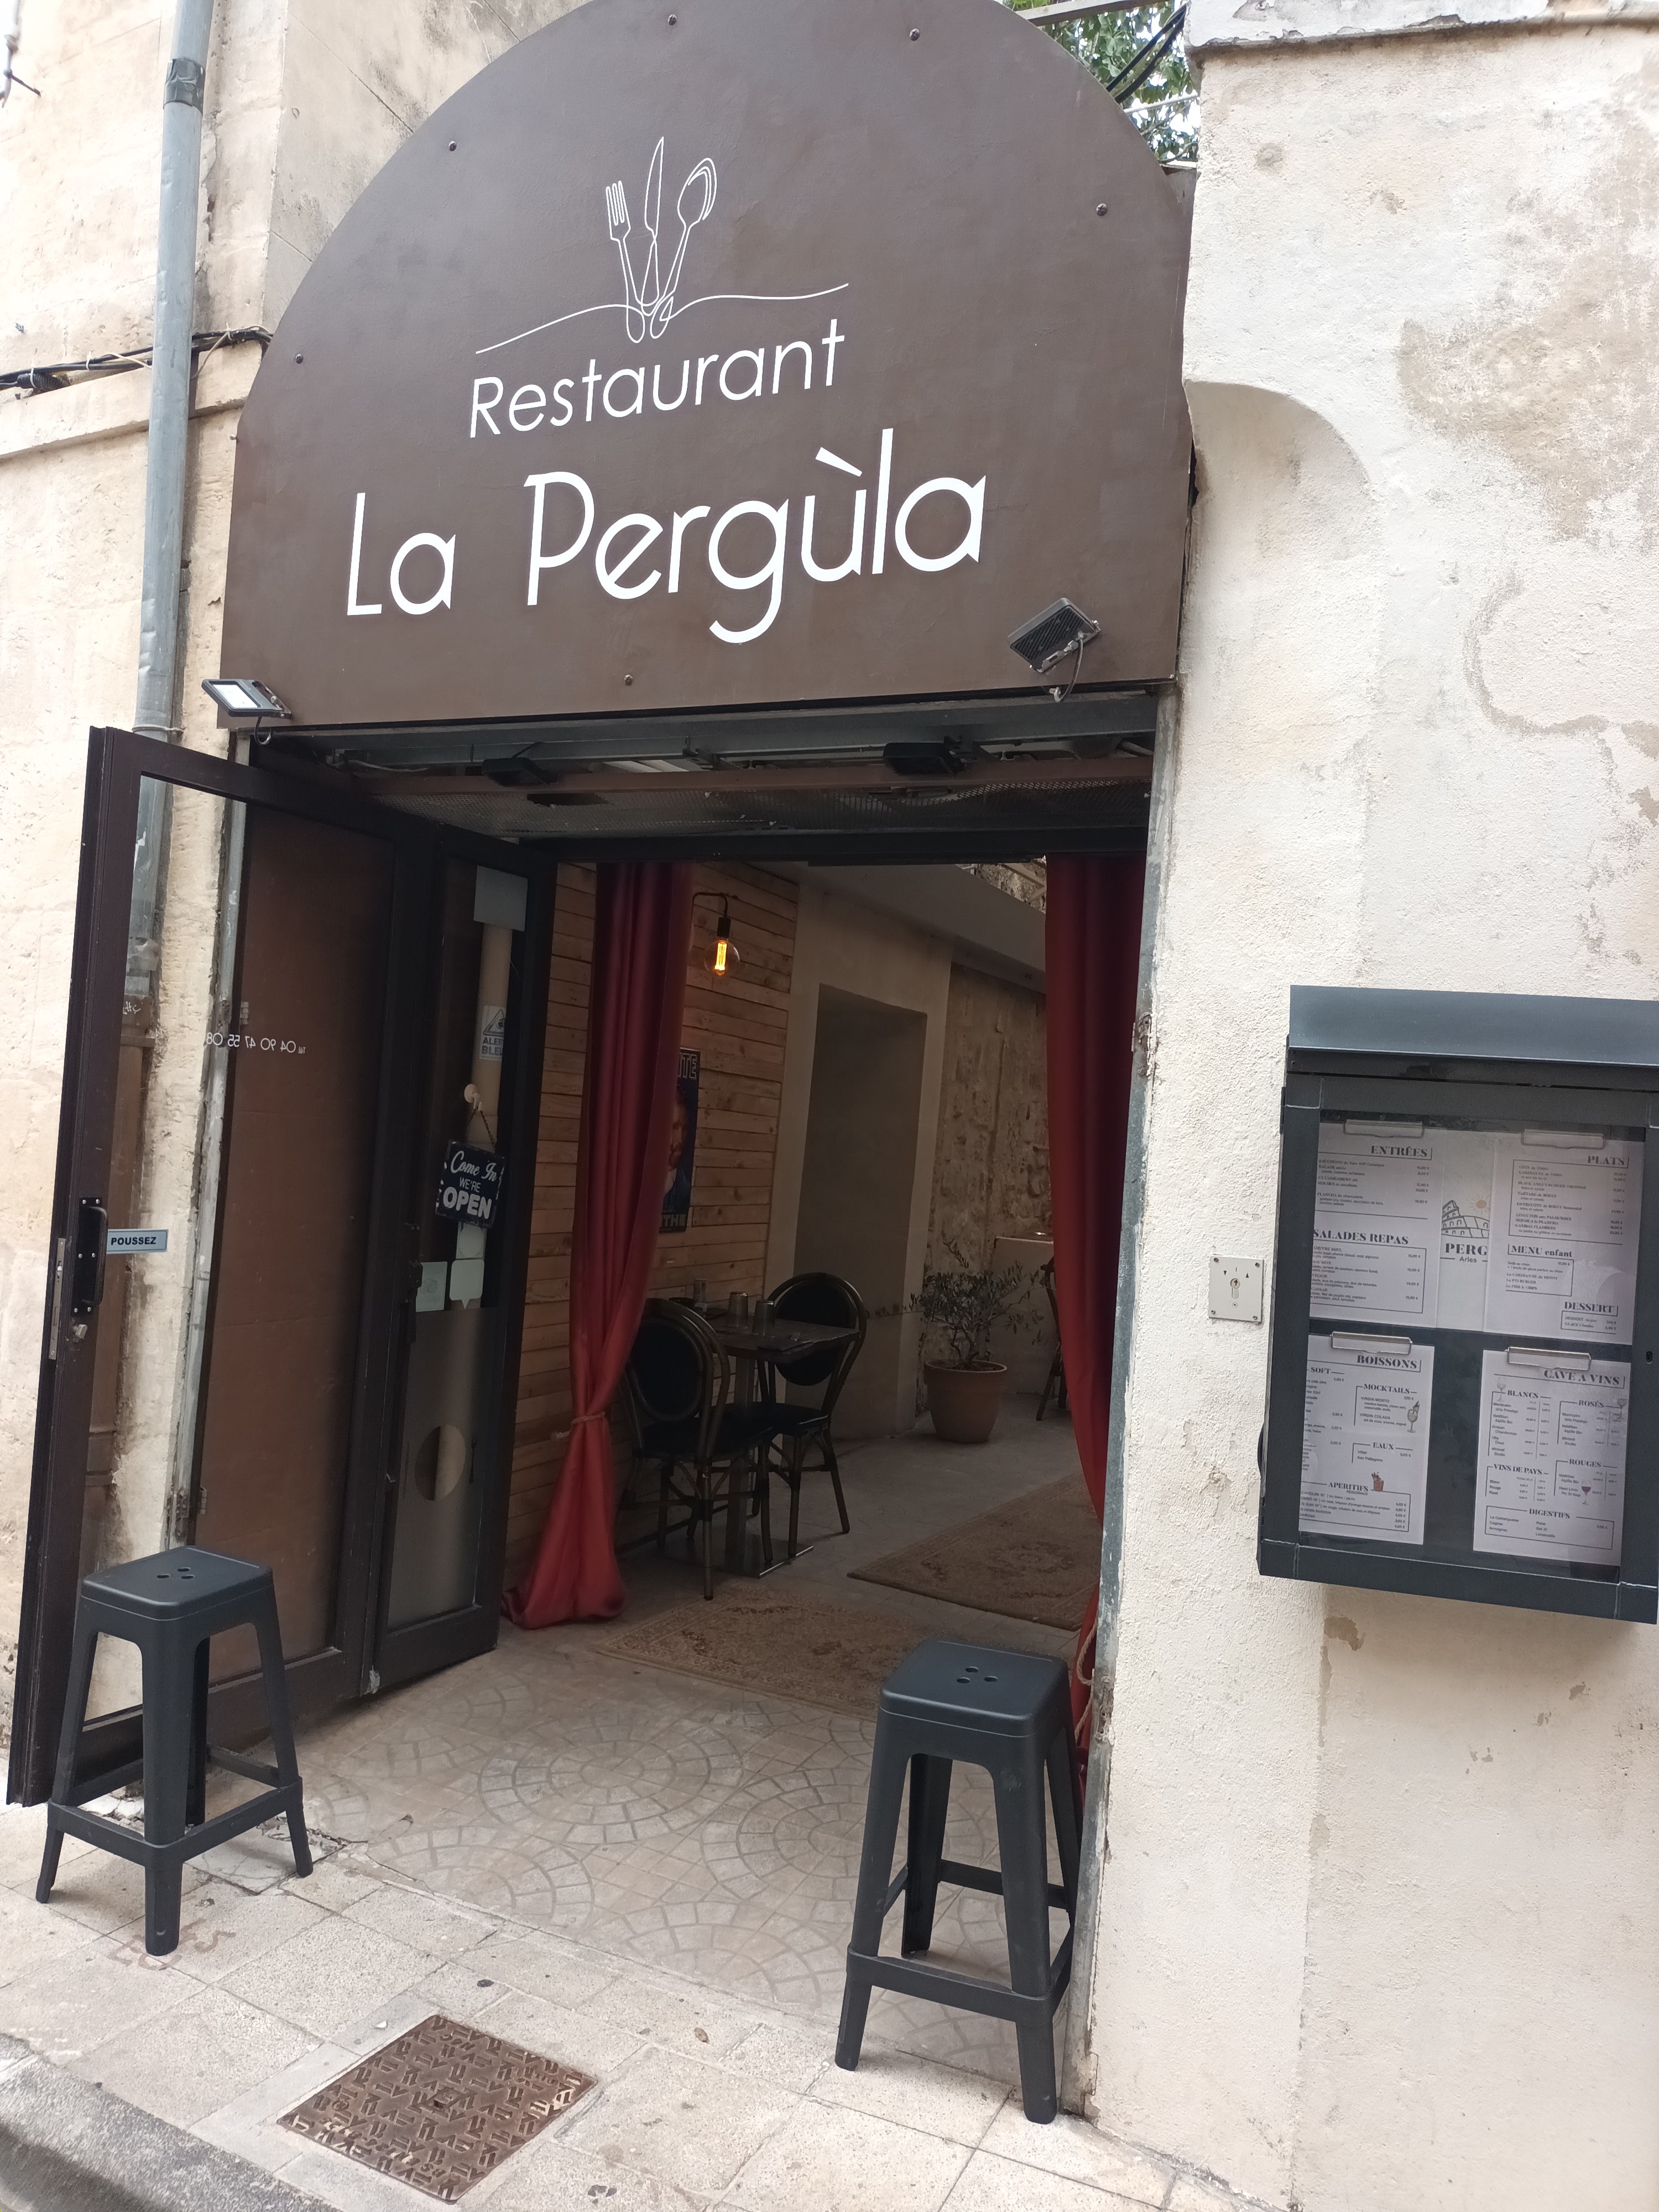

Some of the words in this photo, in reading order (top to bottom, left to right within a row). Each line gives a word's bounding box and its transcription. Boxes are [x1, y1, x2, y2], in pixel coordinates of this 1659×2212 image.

[469, 319, 845, 439] Restaurant
[347, 492, 456, 615] La
[524, 427, 987, 644] Pergùla
[1371, 1145, 1428, 1157] ENTRÉES
[450, 1150, 480, 1176] Come
[481, 1160, 497, 1181] In
[1588, 1156, 1625, 1165] PLATS
[460, 1177, 481, 1193] WE'RE
[443, 1187, 492, 1219] OPEN
[111, 1237, 156, 1245] POUSSEZ
[1313, 1229, 1366, 1241] SALADES
[1370, 1234, 1408, 1244] REPAS
[1511, 1245, 1542, 1255] MENU
[1545, 1249, 1573, 1258] enfant
[1564, 1301, 1614, 1313] DESSERT
[1357, 1355, 1417, 1369] BOISSONS
[1544, 1370, 1576, 1381] CAVE
[1590, 1374, 1620, 1386] VINS
[1363, 1383, 1410, 1394] MOCKTAILS
[1507, 1390, 1539, 1399] BLANCS
[1579, 1400, 1604, 1408] ROSÉS
[1494, 1464, 1512, 1472] VINS
[1569, 1458, 1602, 1468] ROUGES
[1328, 1481, 1369, 1491] APERITIFS
[1529, 1509, 1571, 1519] DIGESTIFS
